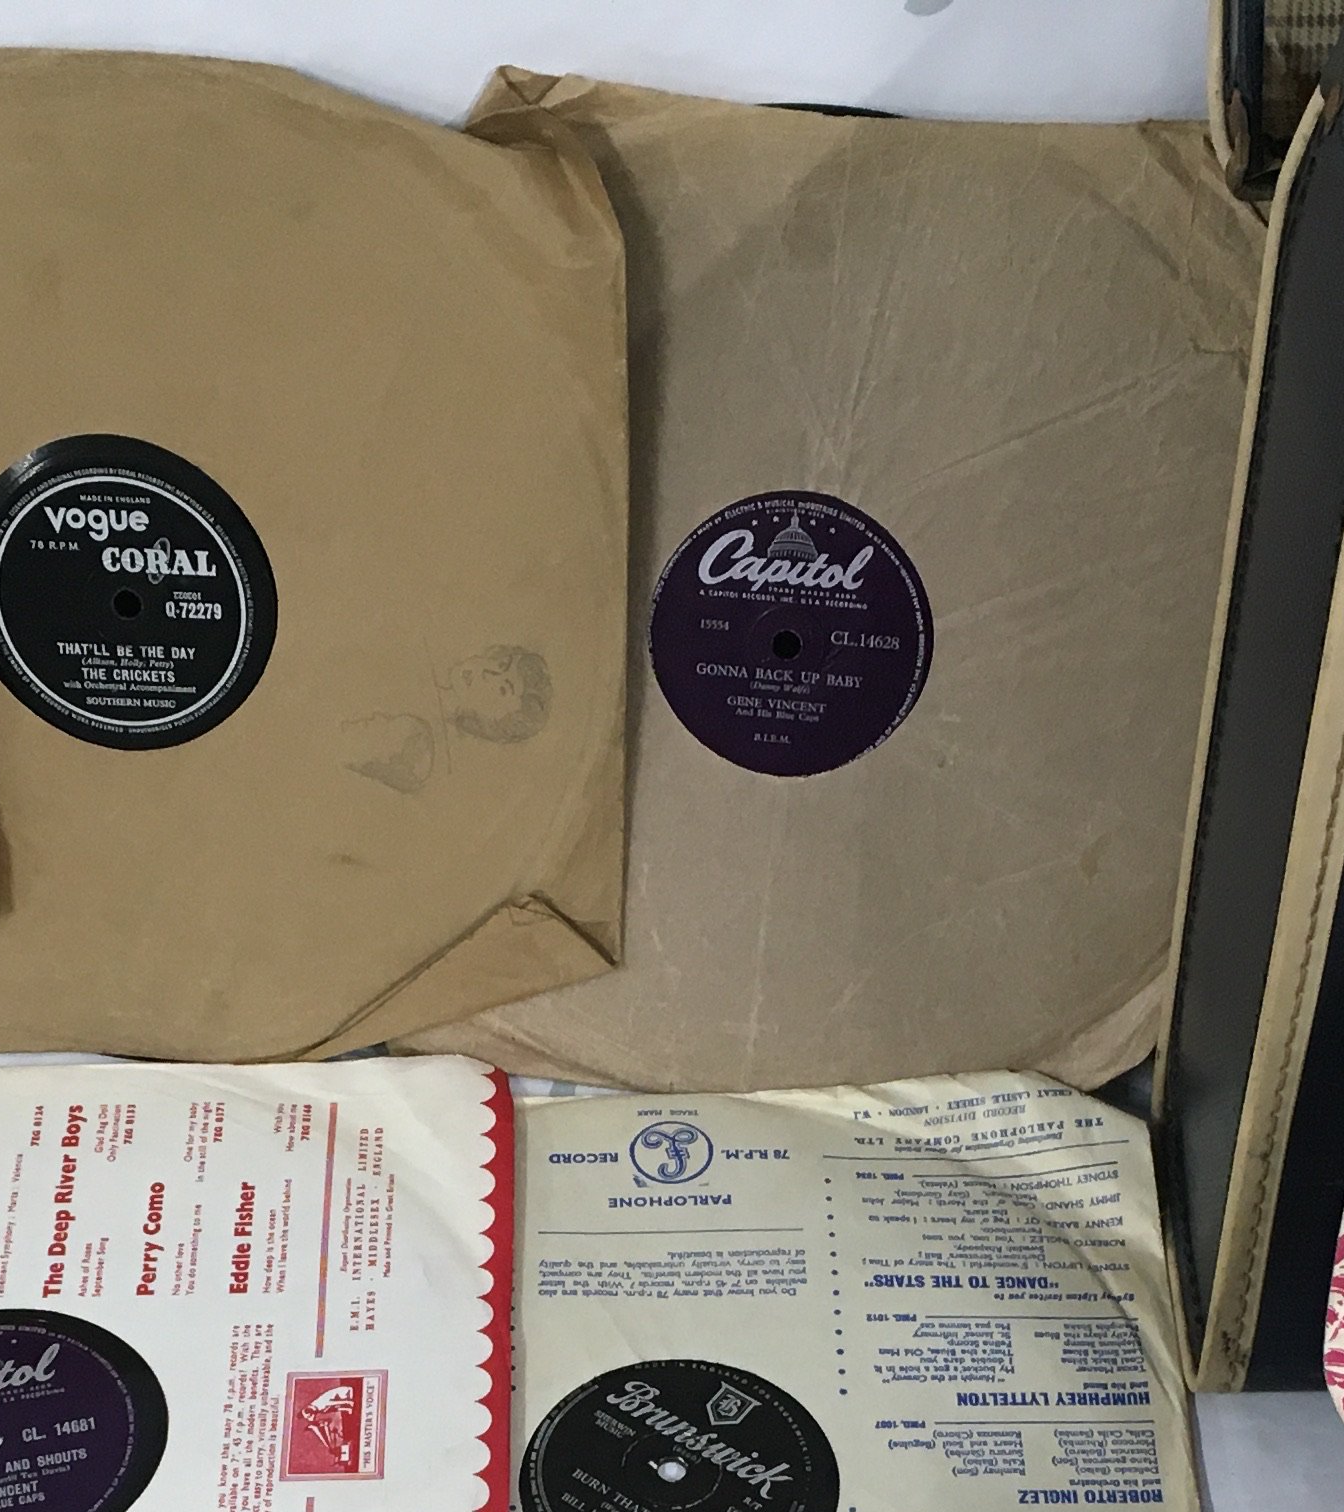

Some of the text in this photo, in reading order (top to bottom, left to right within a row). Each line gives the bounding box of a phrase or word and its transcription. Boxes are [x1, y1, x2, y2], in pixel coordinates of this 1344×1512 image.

[79, 494, 102, 502] MADE
[115, 496, 151, 504] ENGLAND
[30, 539, 45, 549] 78
[102, 546, 217, 577] CORAL
[698, 529, 875, 591] Capitol
[57, 641, 196, 660] THAT'LL BE THE DAY
[81, 668, 175, 683] THE CRICKETS
[696, 663, 863, 688] GONNA BACK UP BABY
[727, 695, 827, 714] GENE VINCENT
[358, 1128, 369, 1171] LIMITED
[549, 1152, 619, 1164] RECORD
[721, 1149, 790, 1160] 78 R.P.M.
[43, 1104, 88, 1298] The Deep River Boys
[608, 1194, 732, 1208] PARLOPHONE
[136, 1181, 165, 1296] Perry Como
[229, 1181, 257, 1294] Eddie Fisher
[352, 1184, 366, 1281] INTERNATIONAL
[864, 1273, 1059, 1289] "DANCE TO THE STARS"
[956, 1392, 1150, 1406] HUMPHREY LYTTELTON
[22, 1417, 96, 1443] CL. 14681
[606, 1381, 794, 1499] Brunswick
[5, 1457, 30, 1475] AND
[37, 1447, 87, 1469] SHOUTS
[571, 1468, 610, 1495] BURN
[561, 1492, 586, 1512] BILL
[1018, 1489, 1164, 1504] ROBERTO INGLEZ
